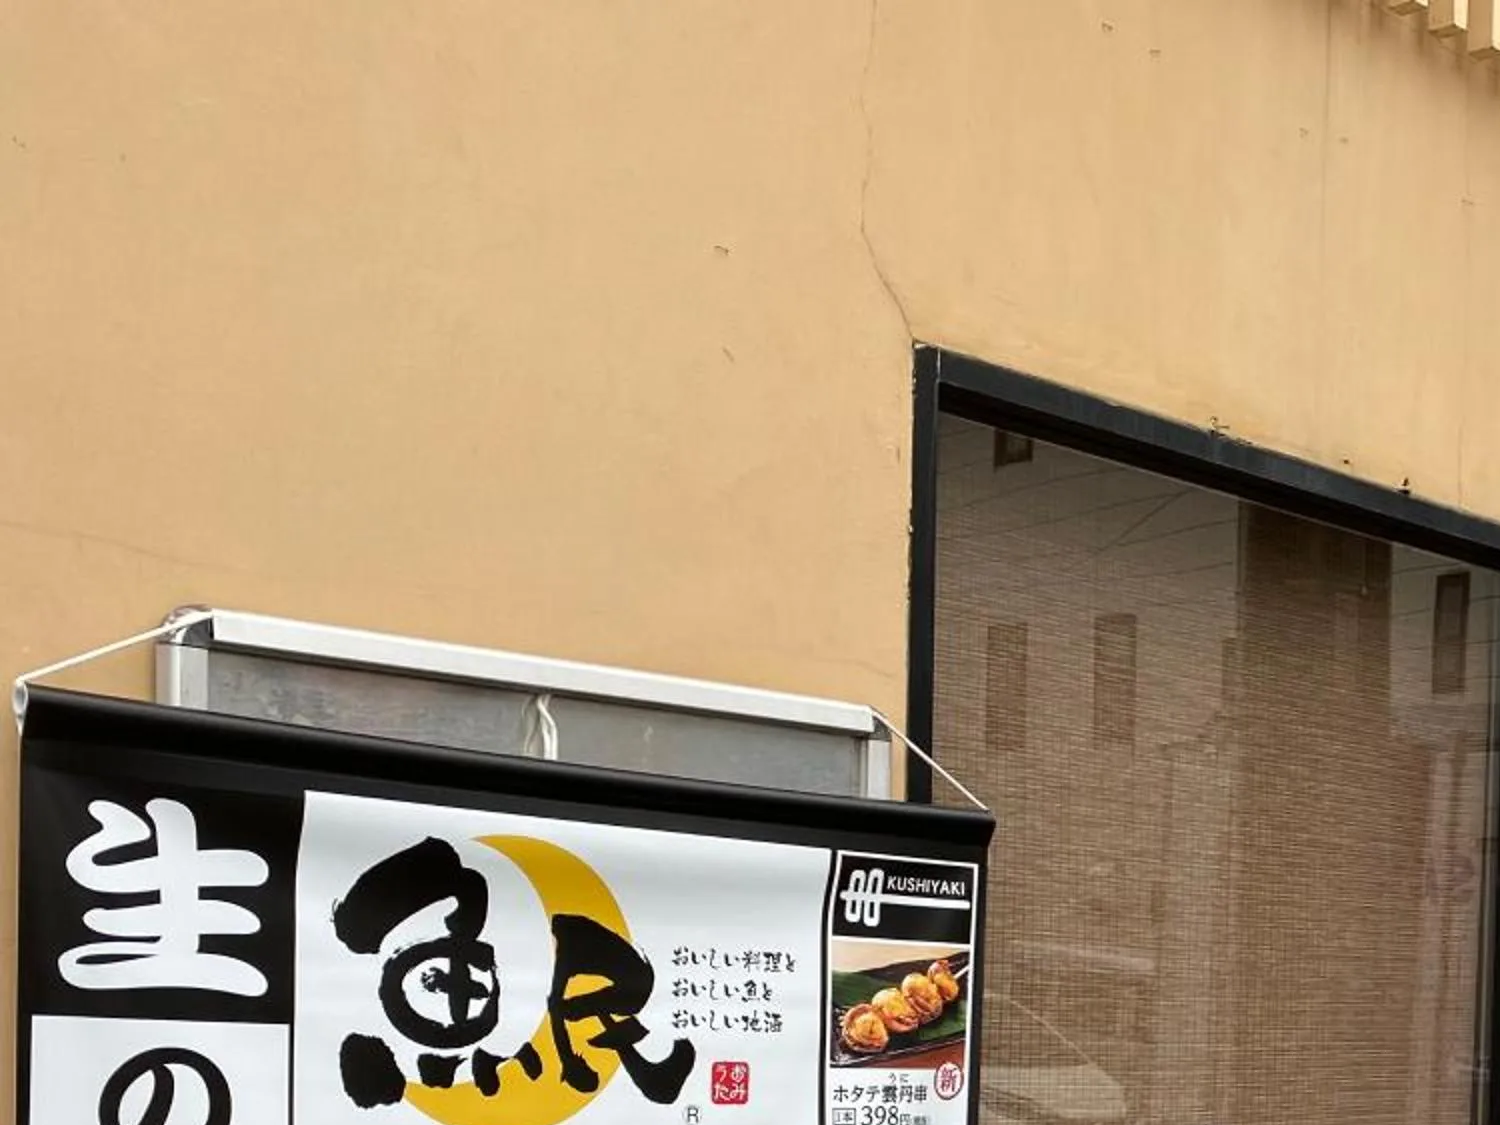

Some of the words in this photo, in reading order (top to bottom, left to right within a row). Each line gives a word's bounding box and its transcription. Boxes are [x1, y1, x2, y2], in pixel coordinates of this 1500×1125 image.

[887, 876, 965, 896] KUSHIYAKI
[672, 946, 796, 972] おいしい料理と
[330, 837, 694, 1107] 魚民
[672, 978, 773, 1002] おいしい魚と
[672, 1010, 783, 1033] おいしい地酒
